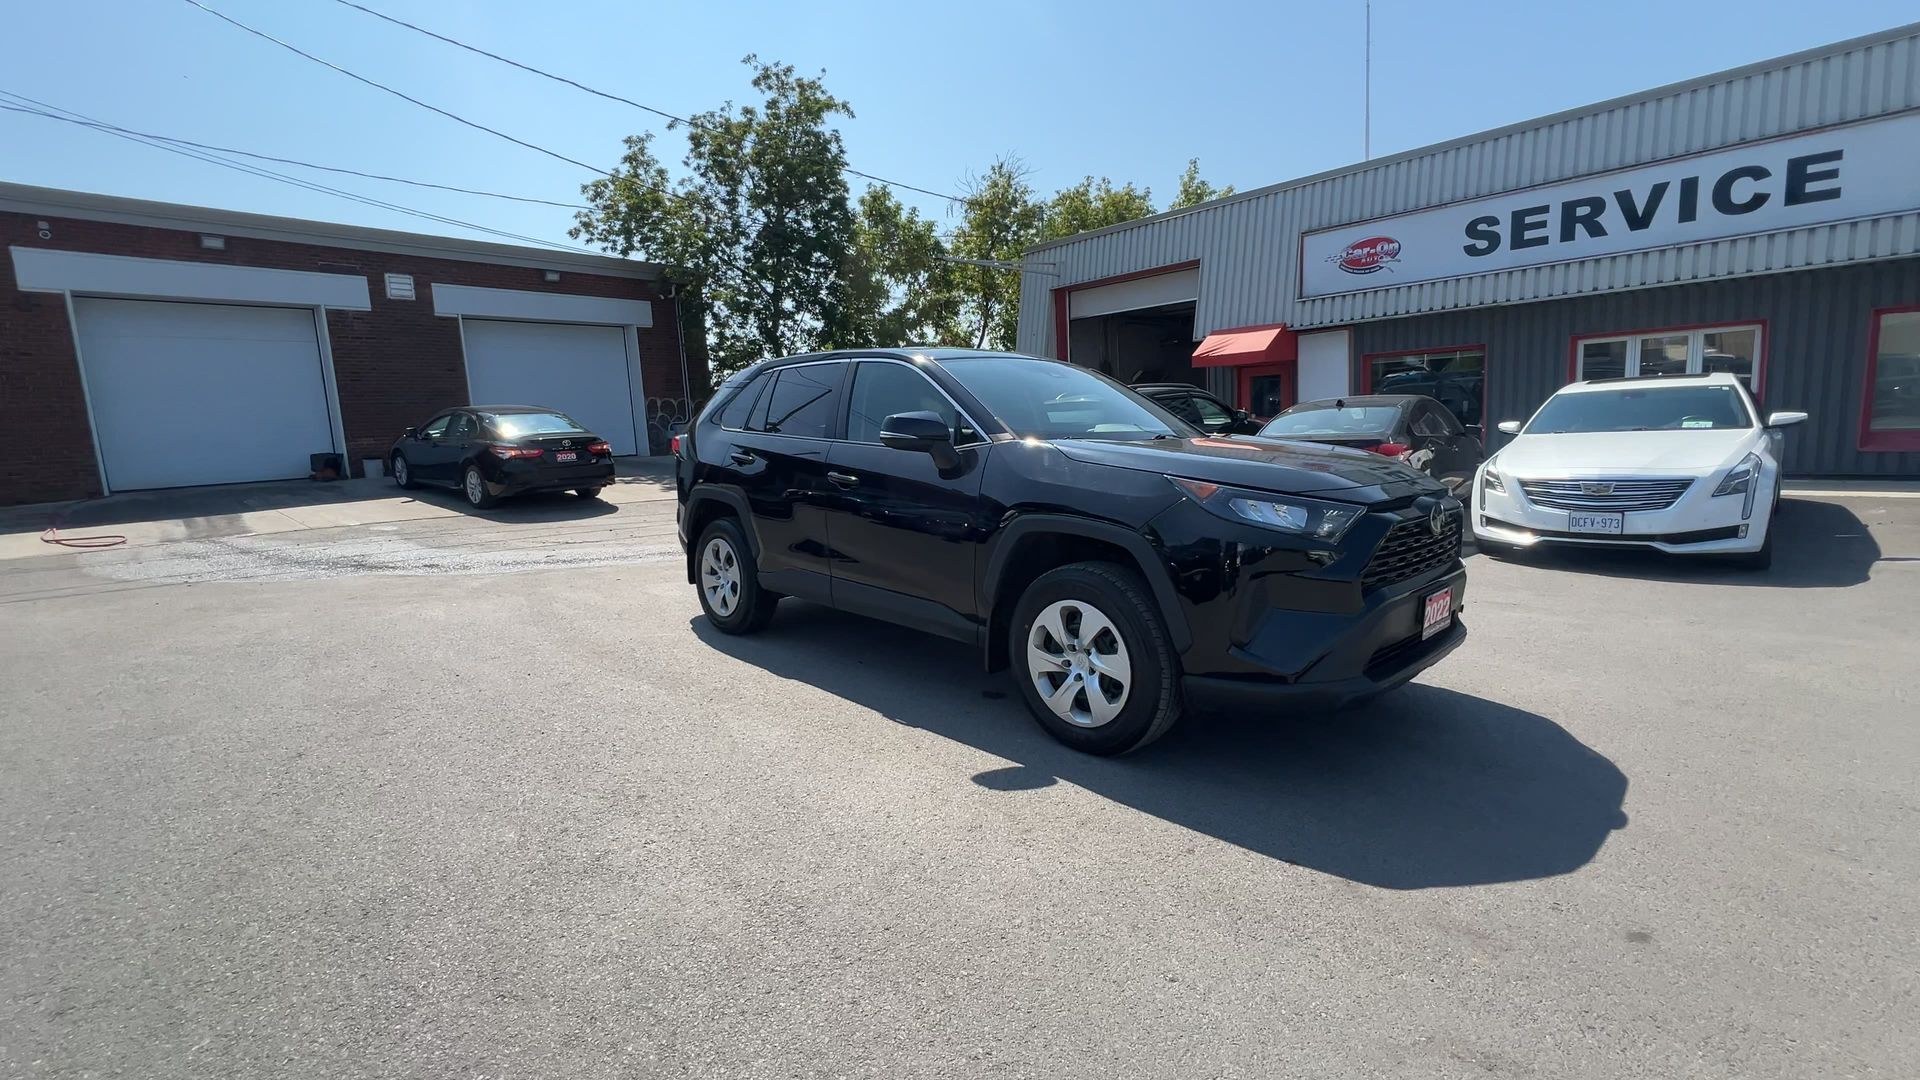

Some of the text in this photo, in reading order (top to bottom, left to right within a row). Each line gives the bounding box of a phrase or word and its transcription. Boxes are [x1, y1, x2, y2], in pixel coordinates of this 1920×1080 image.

[1463, 149, 1844, 257] SERVICE
[557, 453, 577, 461] 2020
[1571, 517, 1620, 529] DCFV-973
[1424, 596, 1450, 628] 2022
